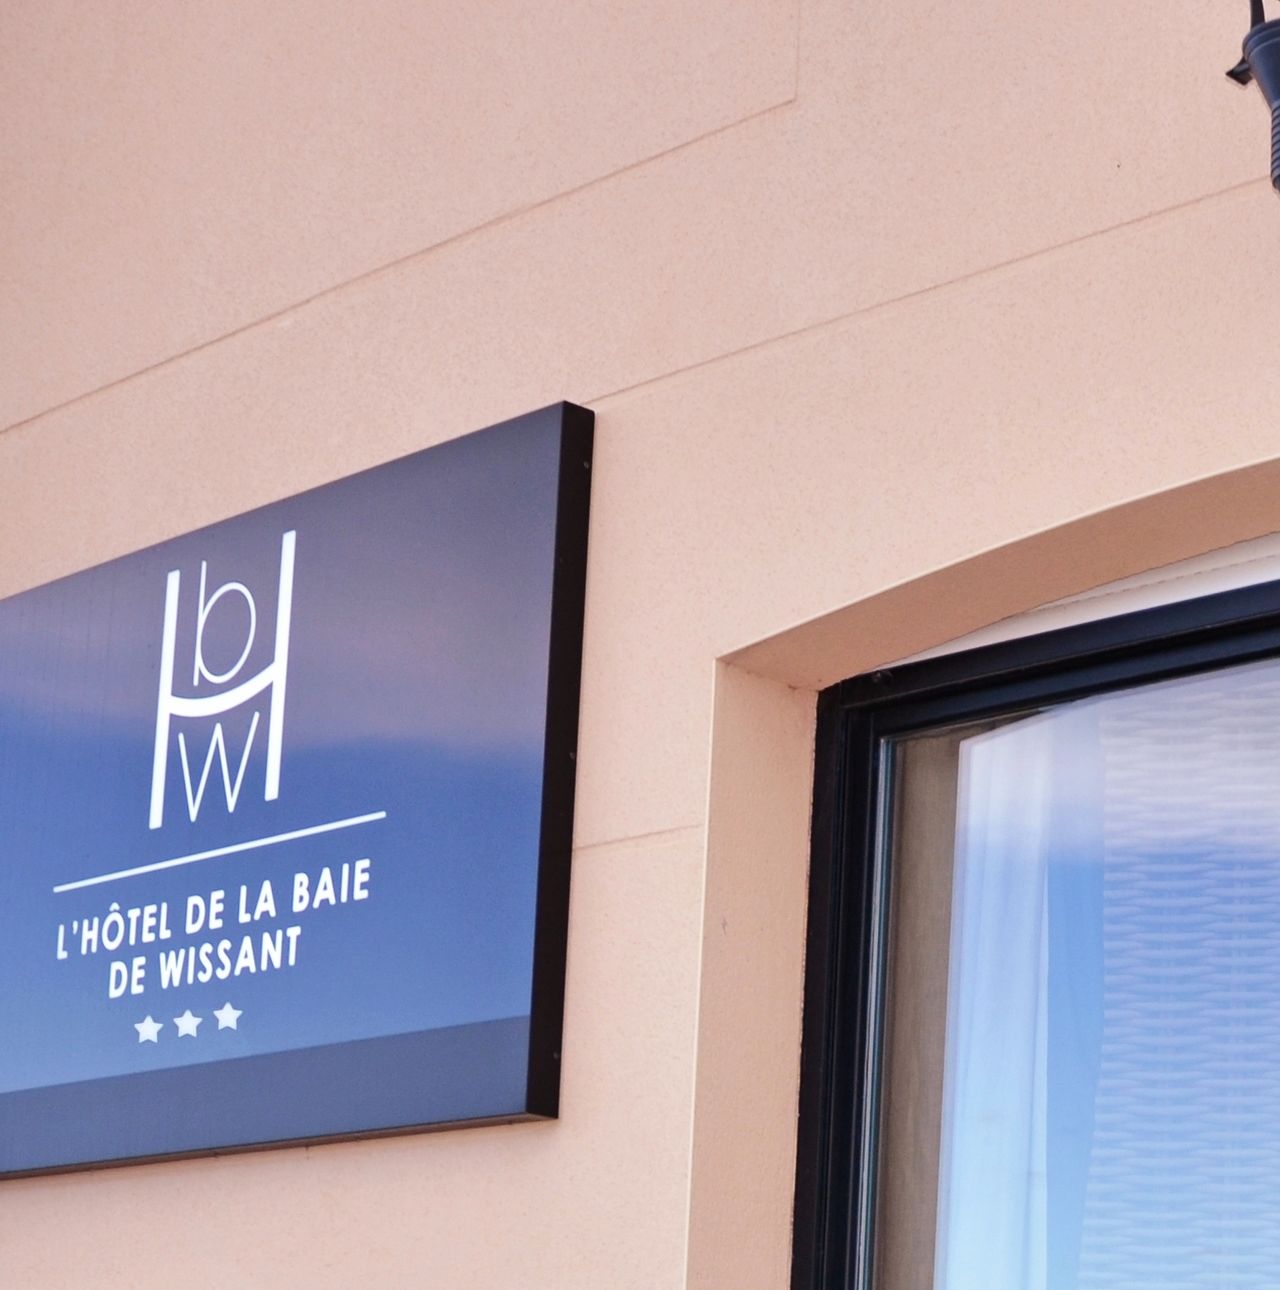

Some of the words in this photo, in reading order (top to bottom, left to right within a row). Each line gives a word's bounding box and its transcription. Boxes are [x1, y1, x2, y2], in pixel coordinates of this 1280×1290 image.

[56, 901, 172, 960] L'HÔTEL
[185, 889, 226, 935] DE
[238, 879, 277, 924] LA
[292, 858, 371, 913] BAIE
[108, 955, 147, 999] DE
[159, 925, 302, 989] WISSANT
